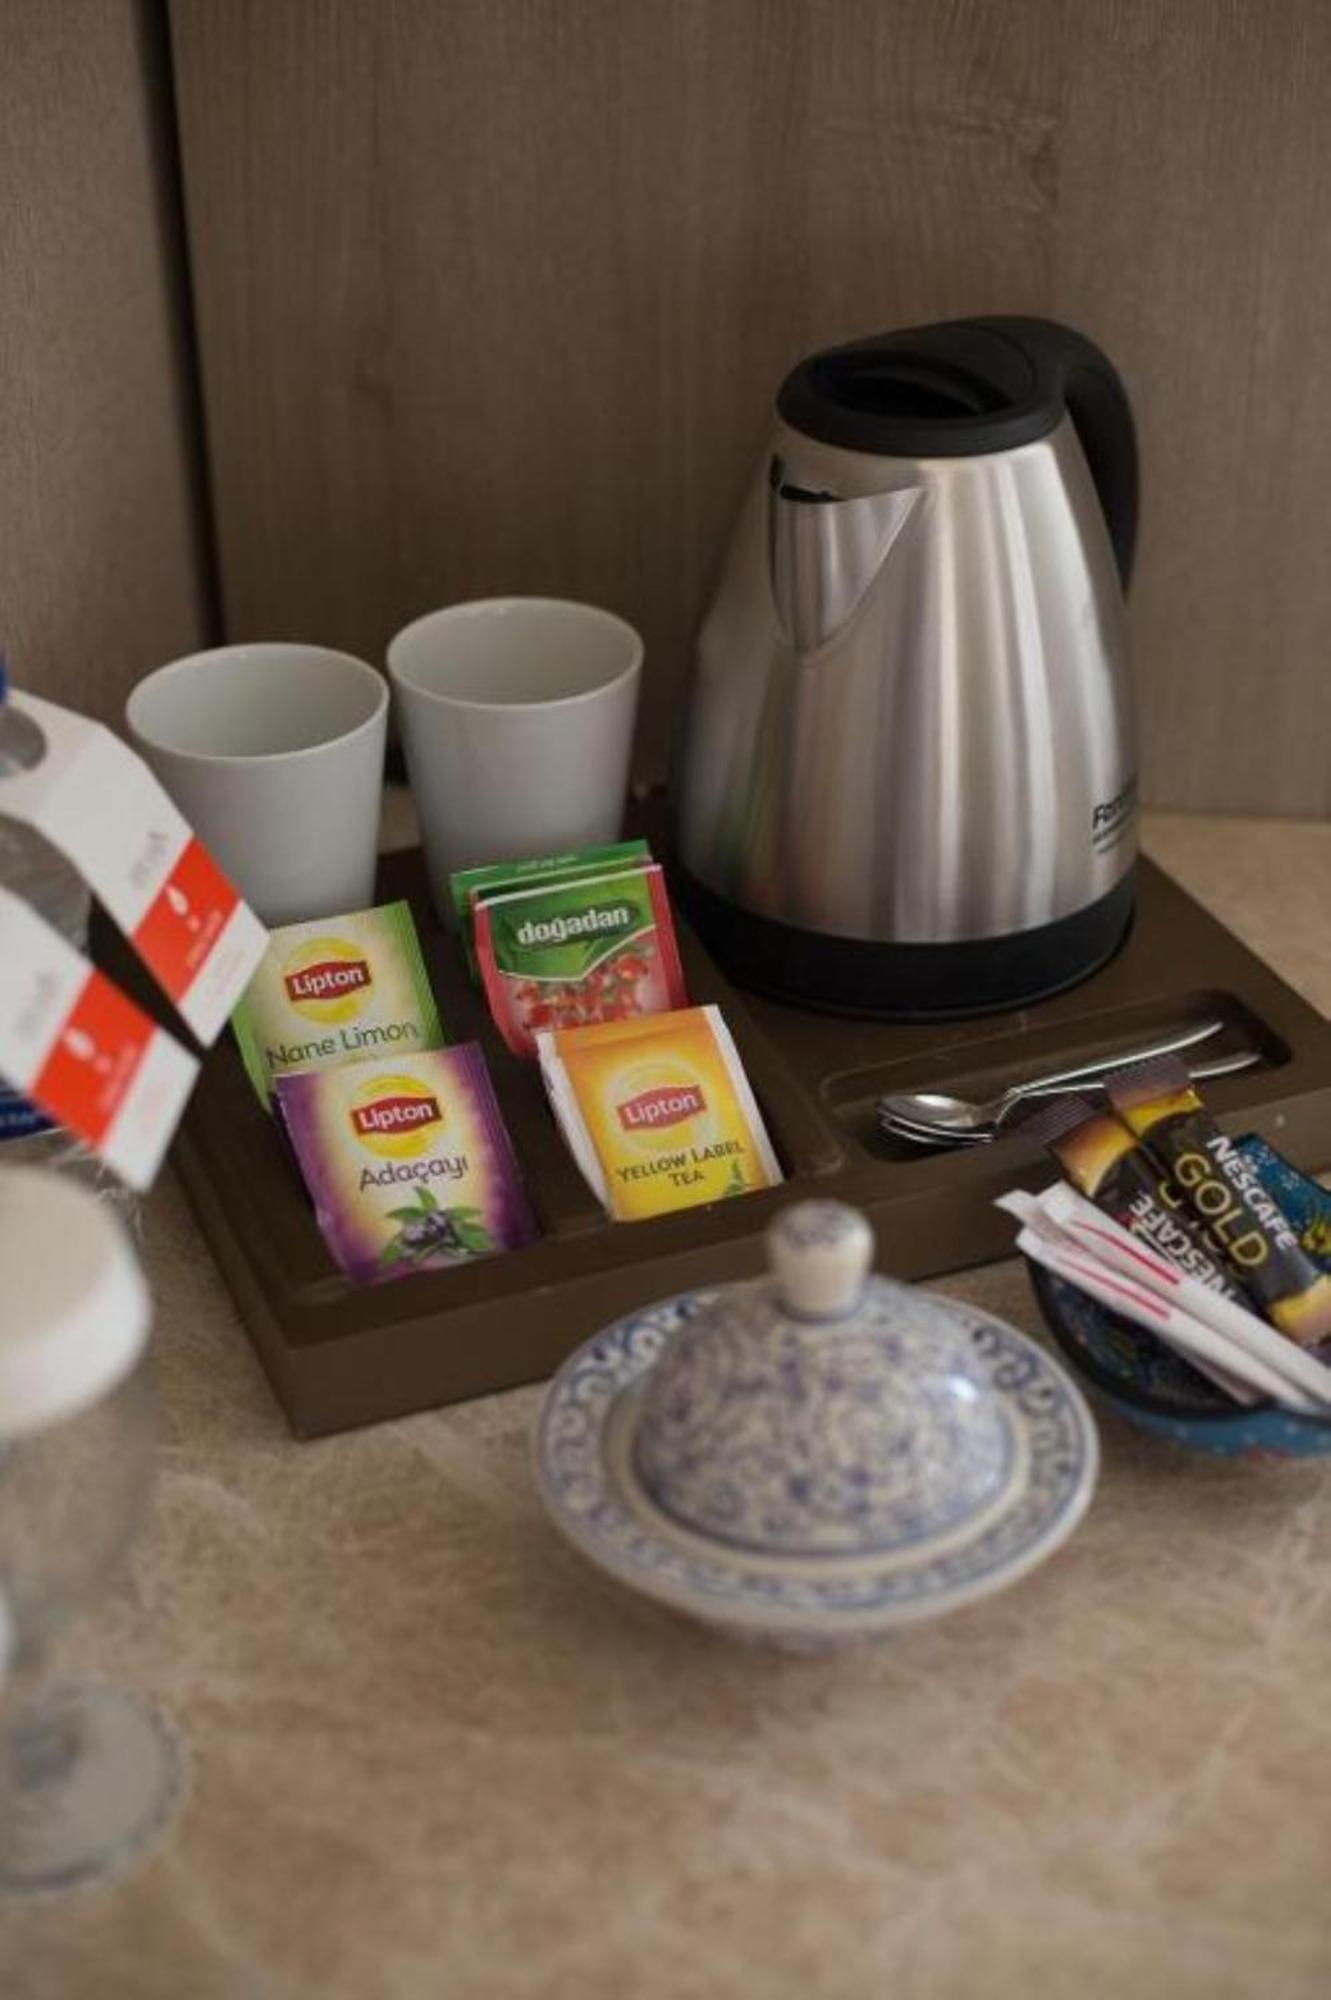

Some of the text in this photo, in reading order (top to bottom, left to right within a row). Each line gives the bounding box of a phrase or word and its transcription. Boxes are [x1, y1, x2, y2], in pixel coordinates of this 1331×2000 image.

[292, 967, 364, 995] Lipton
[266, 1022, 417, 1068] Nane Limon
[359, 1103, 433, 1130] Lipton
[624, 1094, 698, 1123] Lipton
[616, 1139, 743, 1184] YELLOW LABEL
[667, 1168, 704, 1188] TEA
[1174, 1153, 1268, 1266] GOLD
